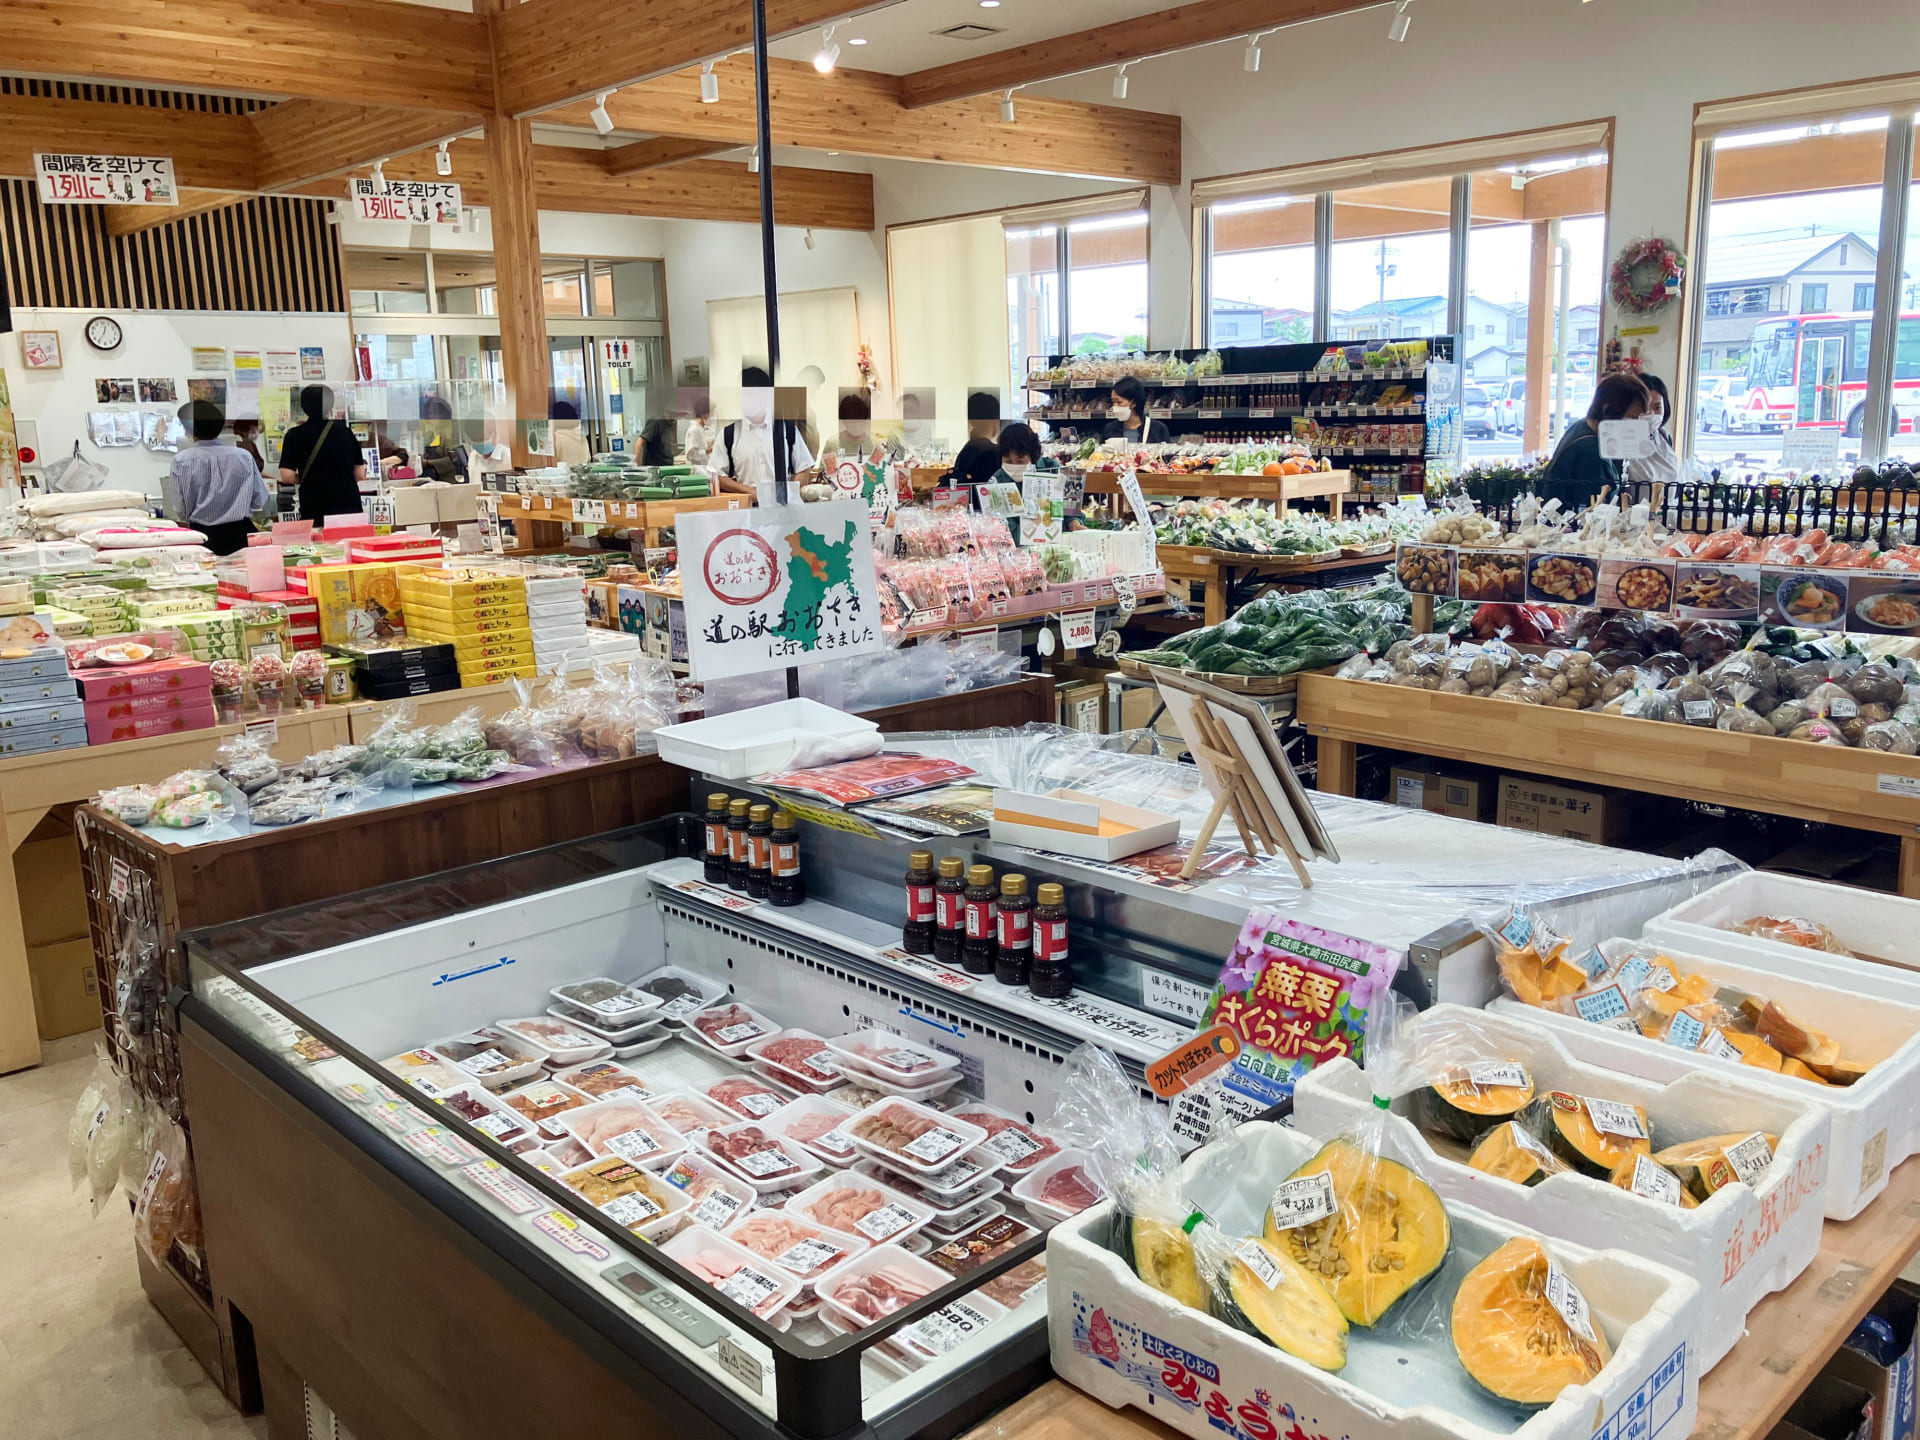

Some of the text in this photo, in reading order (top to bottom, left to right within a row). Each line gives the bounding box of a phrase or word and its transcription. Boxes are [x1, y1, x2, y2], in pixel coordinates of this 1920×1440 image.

[41, 154, 166, 174] 間隔を空けて
[47, 174, 106, 199] 1列に
[360, 197, 406, 219] 1列に
[723, 550, 756, 566] 道の駅
[714, 565, 768, 585] おおさき
[702, 596, 861, 644] 道の駅おおさき
[1070, 625, 1090, 639] 2,880
[769, 625, 874, 658] に行ってきました
[1269, 933, 1363, 973] 宮城県大崎市田尻産
[1257, 959, 1340, 1018] 蕪栗
[1215, 996, 1349, 1058] さくらポーク
[1154, 1045, 1213, 1090] カットかぼちゃ
[1227, 1071, 1291, 1103] 式会社 ミート大
[1144, 1333, 1218, 1380] 土佐くろしおの
